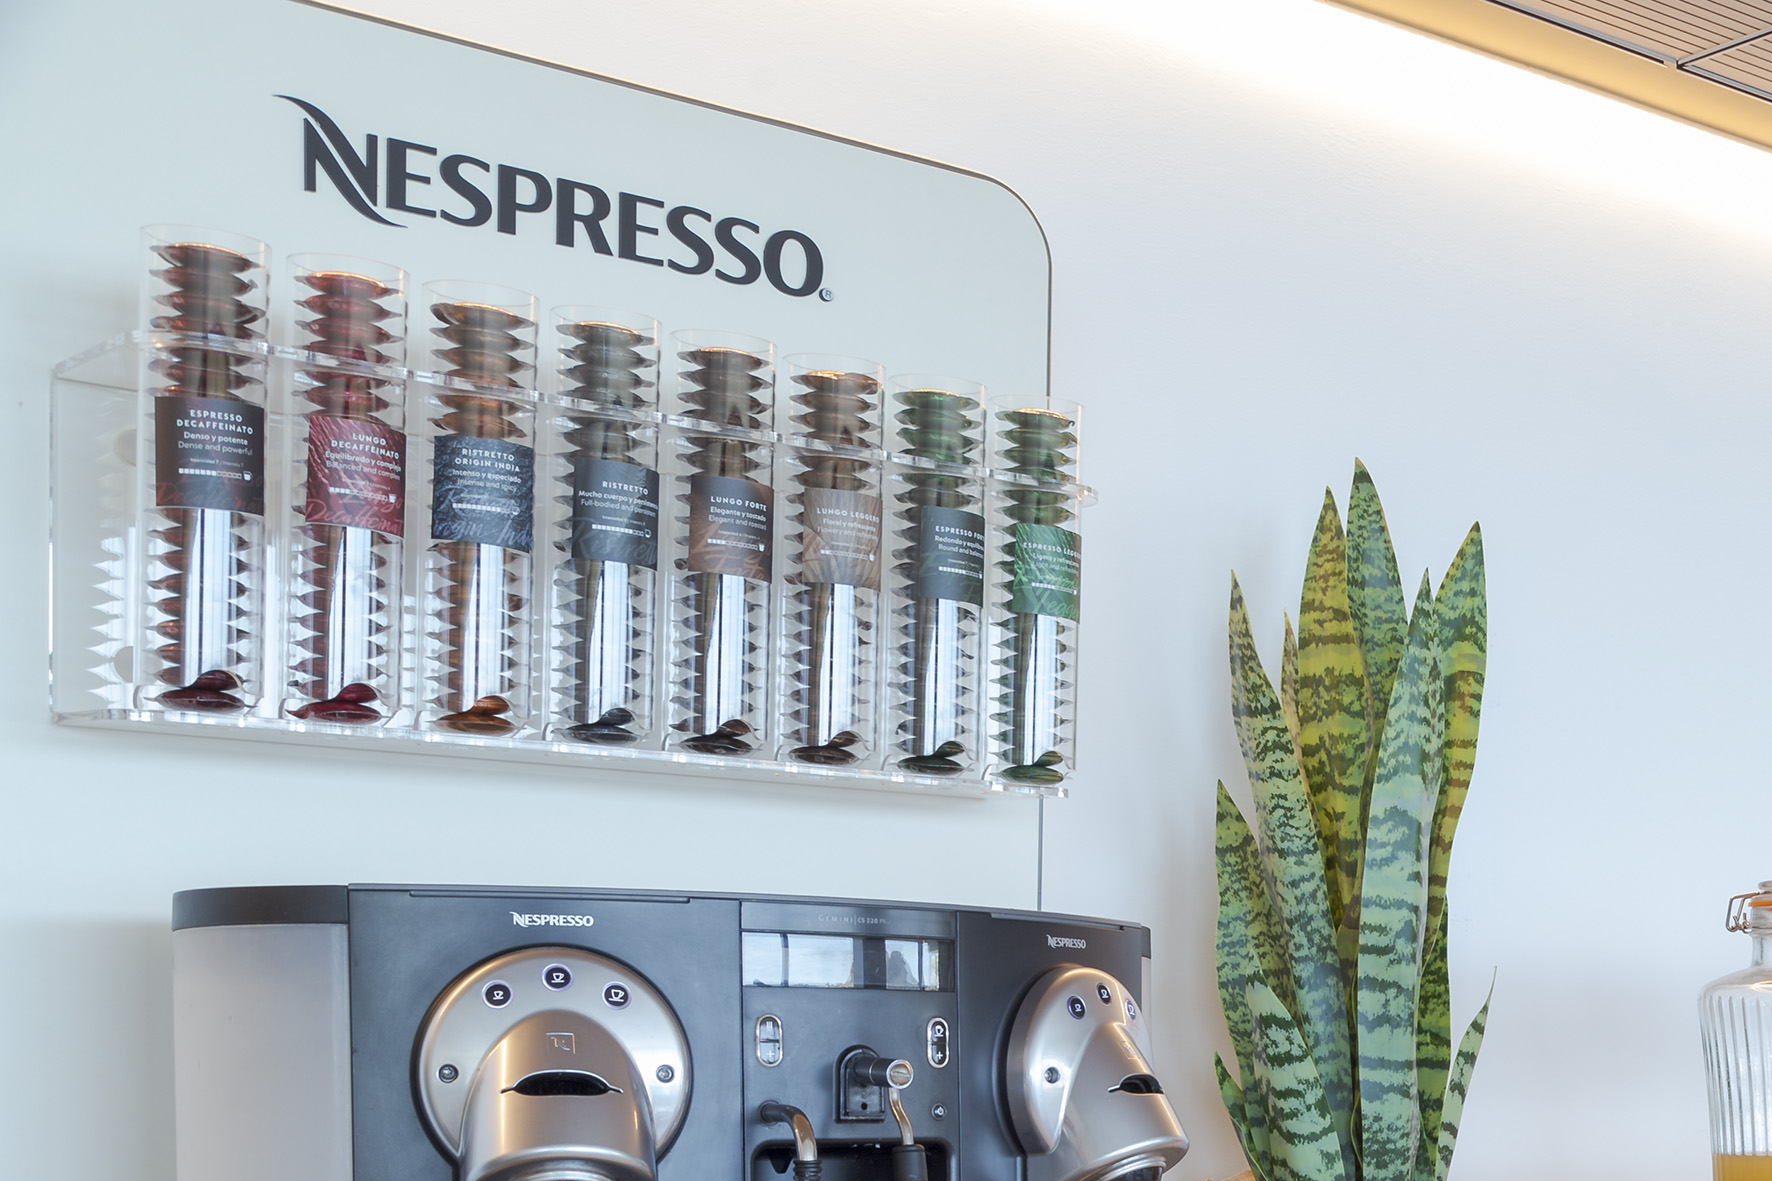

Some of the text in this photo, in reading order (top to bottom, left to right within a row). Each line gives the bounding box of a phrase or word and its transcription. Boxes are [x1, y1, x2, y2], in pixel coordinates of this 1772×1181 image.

[273, 94, 824, 299] NESPRESSO
[190, 410, 242, 422] ESPRESSO
[176, 419, 253, 434] DECAFFEINATO
[184, 431, 210, 440] Denso
[218, 436, 248, 445] potente
[352, 433, 386, 445] LUNGO
[178, 441, 203, 449] Dense
[222, 446, 252, 456] powerful
[331, 440, 399, 459] DECAFFEINATO
[462, 448, 514, 461] RISTRETTO
[325, 450, 370, 463] Equilibrado
[326, 461, 361, 471] Balanced
[363, 466, 377, 475] and
[455, 458, 520, 472] ORIGIN INDIA
[453, 469, 480, 477] Intenso
[487, 472, 521, 483] especiado
[501, 484, 517, 493] spicy
[602, 481, 648, 495] RISTRETTO
[579, 490, 602, 498] Mucho
[604, 493, 628, 502] cuerpo
[581, 499, 619, 509] Full-bodied
[711, 496, 766, 511] LUNGO FORTE
[710, 506, 740, 516] Elegante
[709, 515, 734, 523] Elegant
[823, 518, 842, 526] Floral
[935, 526, 972, 537] ESPRESSO
[935, 535, 962, 545] Redondo
[939, 544, 958, 552] Round
[1023, 542, 1062, 553] ESPRESSO
[509, 912, 594, 927] NESPRESSO
[1046, 934, 1086, 949] NESPRESSO
